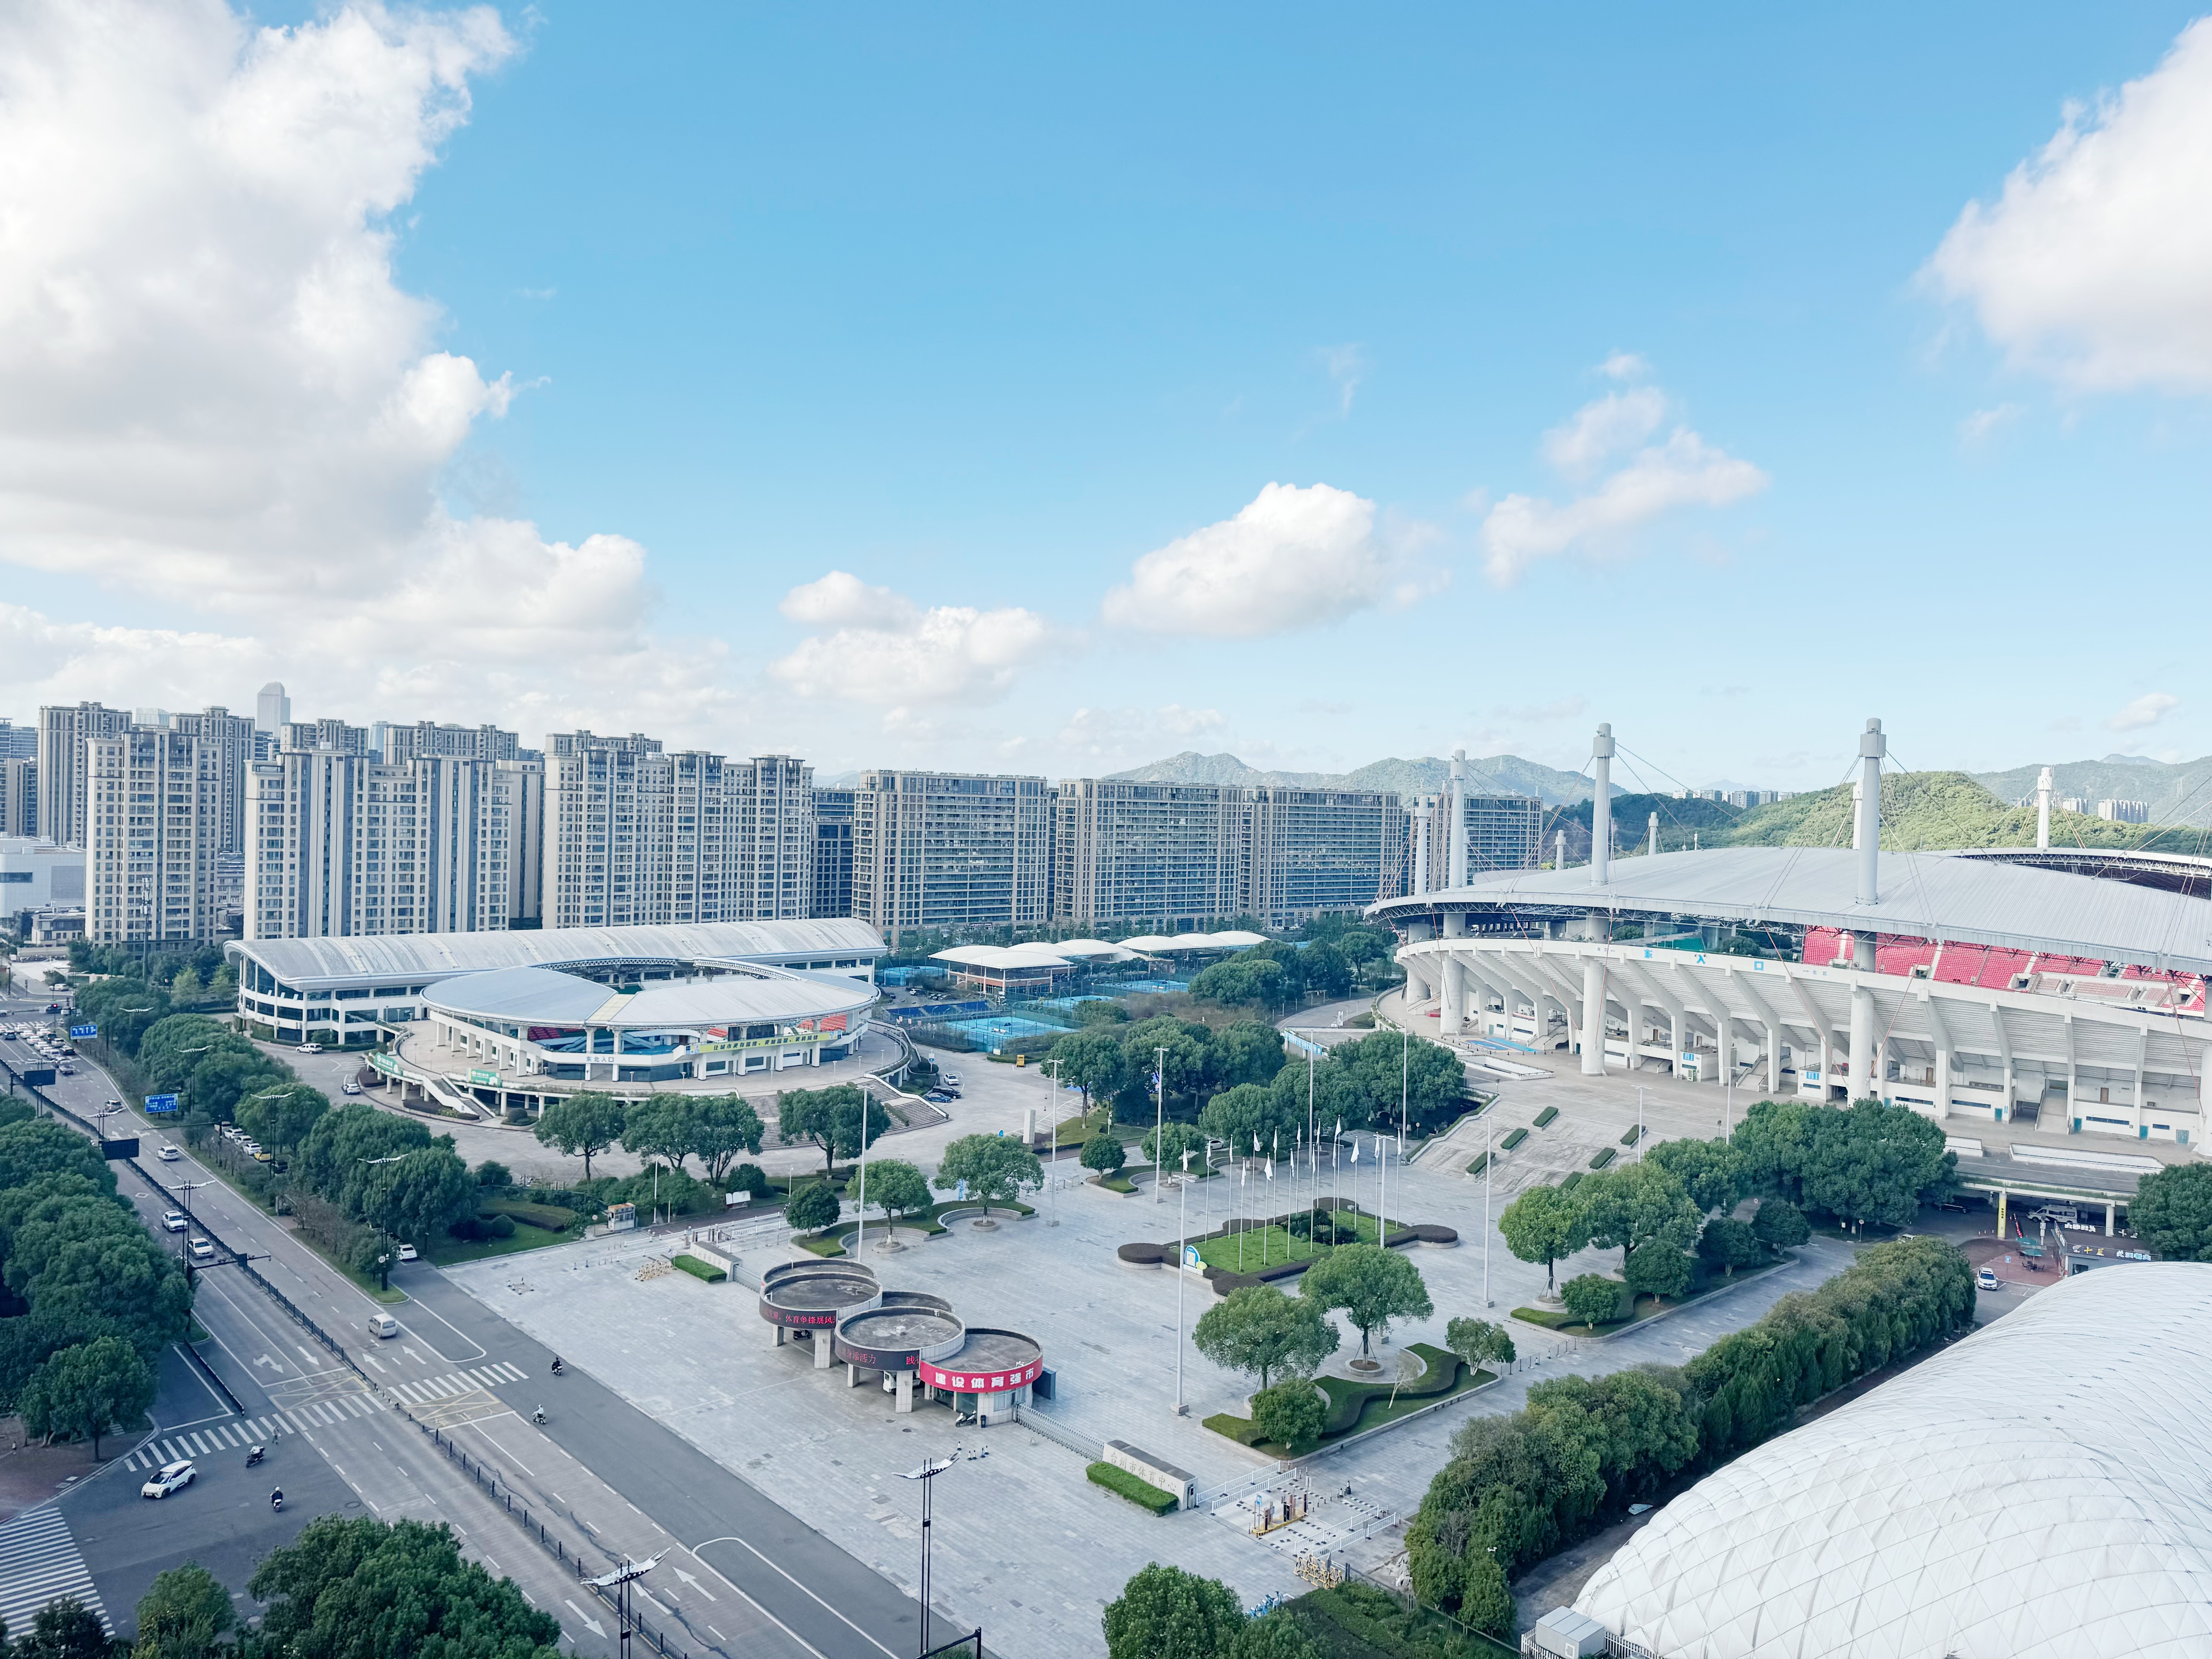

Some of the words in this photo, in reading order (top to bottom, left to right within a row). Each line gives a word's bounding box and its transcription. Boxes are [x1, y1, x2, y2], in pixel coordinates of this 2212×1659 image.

[1644, 949, 1764, 971] 东入口
[935, 1367, 1034, 1388] 建设体育强市
[1111, 1453, 1176, 1491] 台州市体育中心
